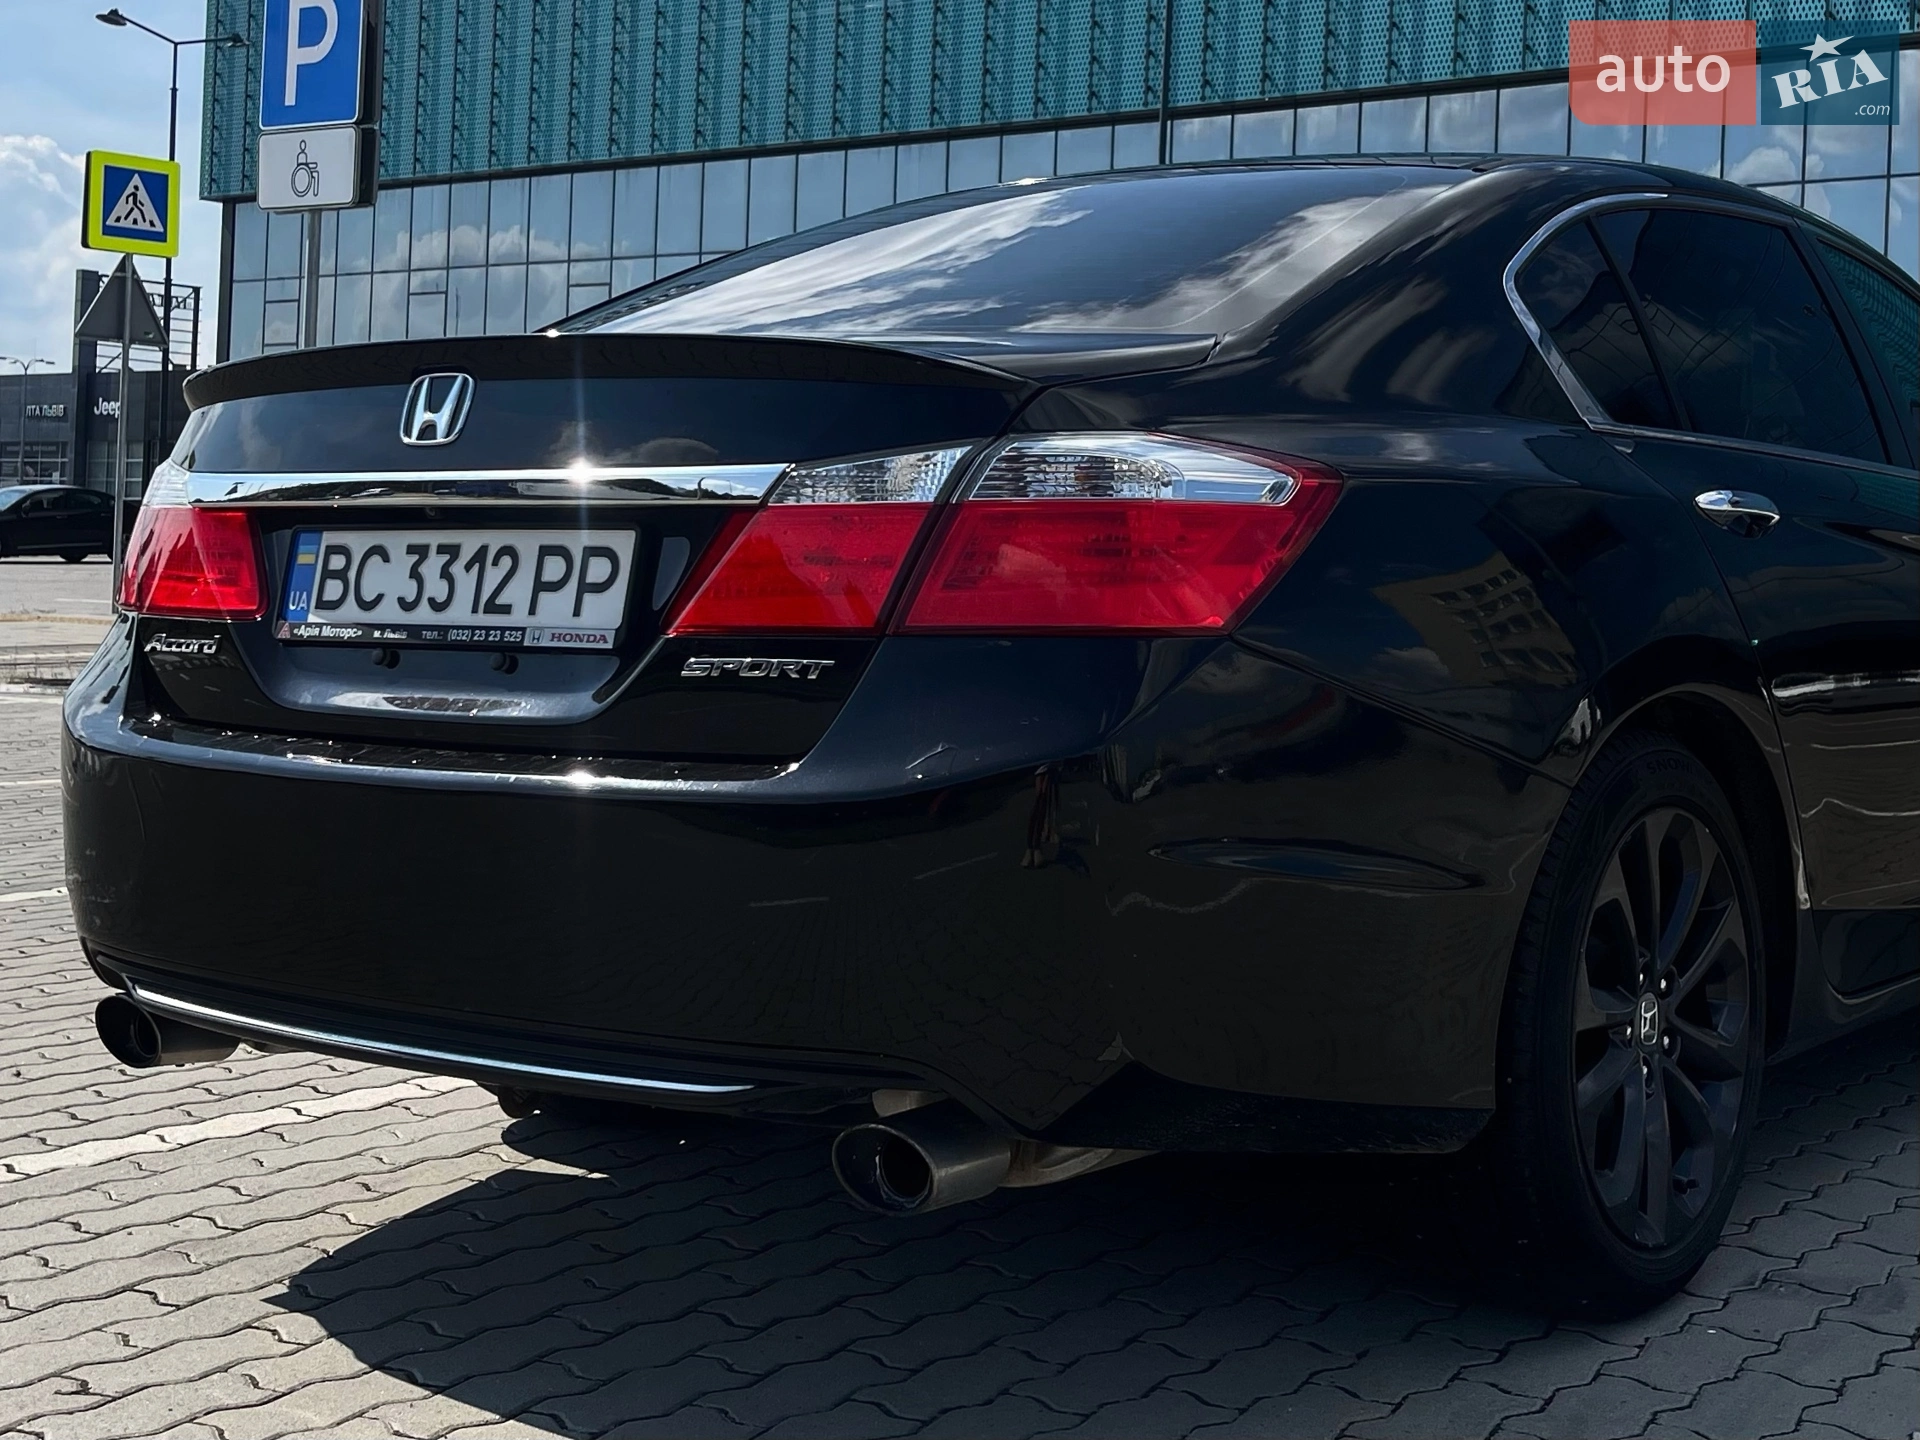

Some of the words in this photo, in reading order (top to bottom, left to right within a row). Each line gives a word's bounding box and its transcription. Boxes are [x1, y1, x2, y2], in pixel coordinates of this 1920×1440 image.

[284, 0, 339, 106] P
[396, 542, 520, 615] 3312
[288, 590, 308, 611] UA
[143, 633, 221, 654] Accord
[447, 628, 472, 643] (032)
[474, 629, 486, 641] 23
[488, 629, 501, 642] 23
[503, 629, 523, 642] 525
[549, 632, 609, 644] HONDA
[680, 657, 836, 680] SPORT
